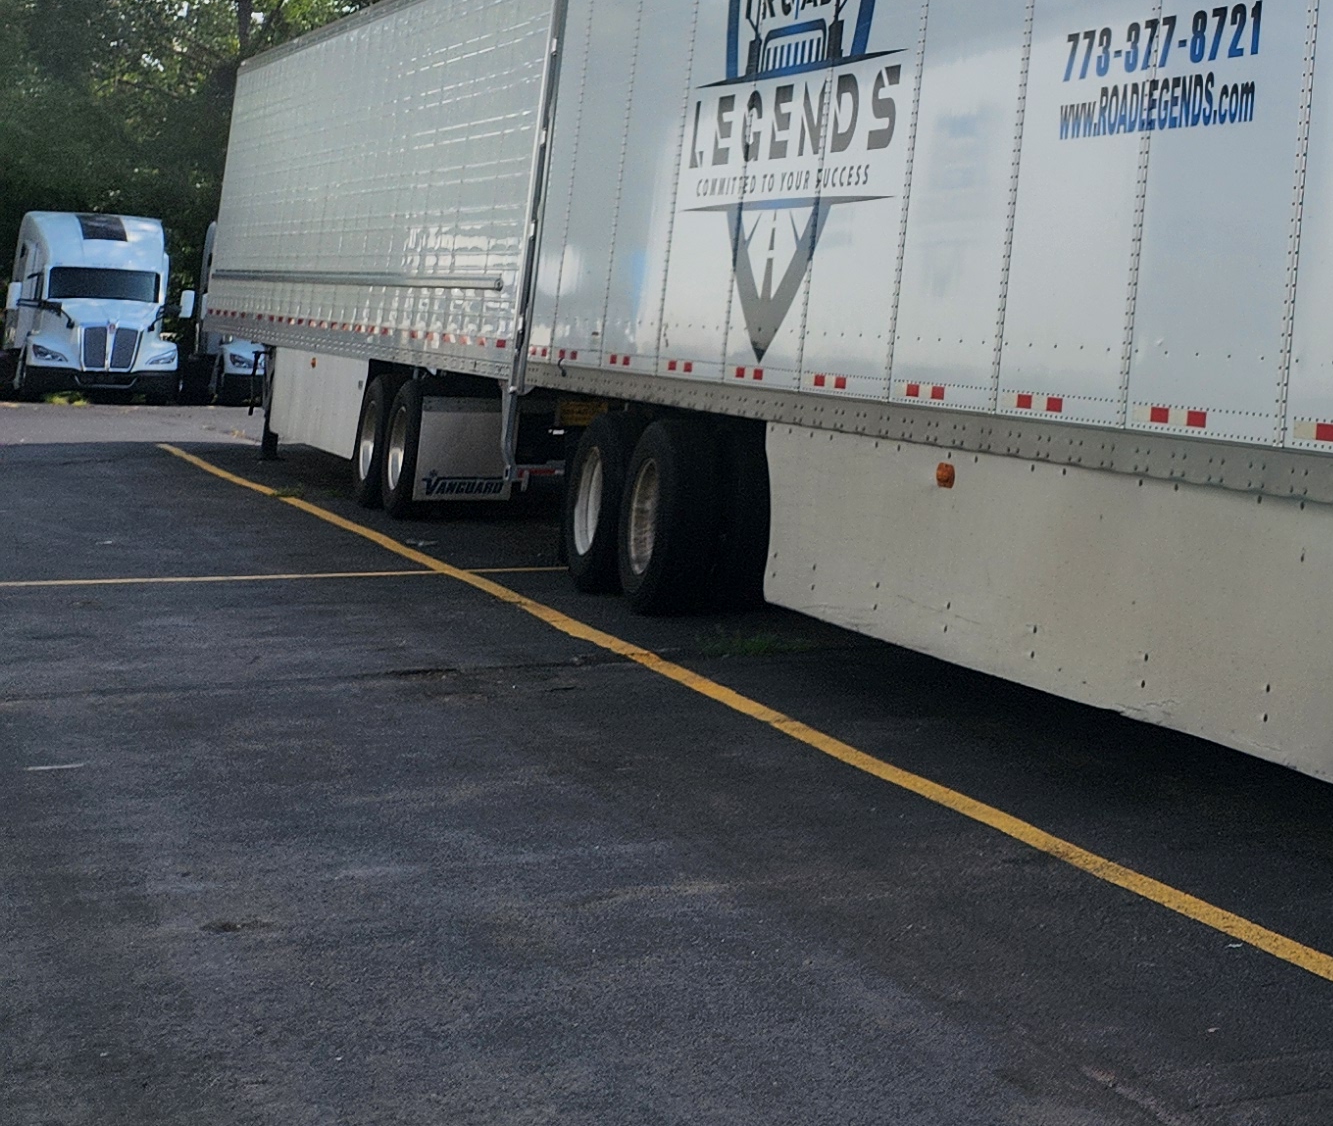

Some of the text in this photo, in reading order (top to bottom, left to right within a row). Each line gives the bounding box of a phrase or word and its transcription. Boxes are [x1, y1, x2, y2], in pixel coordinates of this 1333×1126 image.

[1063, 0, 1263, 82] 773-377-8721
[688, 64, 902, 169] LEGENDS
[696, 164, 870, 197] COMMITTED TO YOUR SUCCESS
